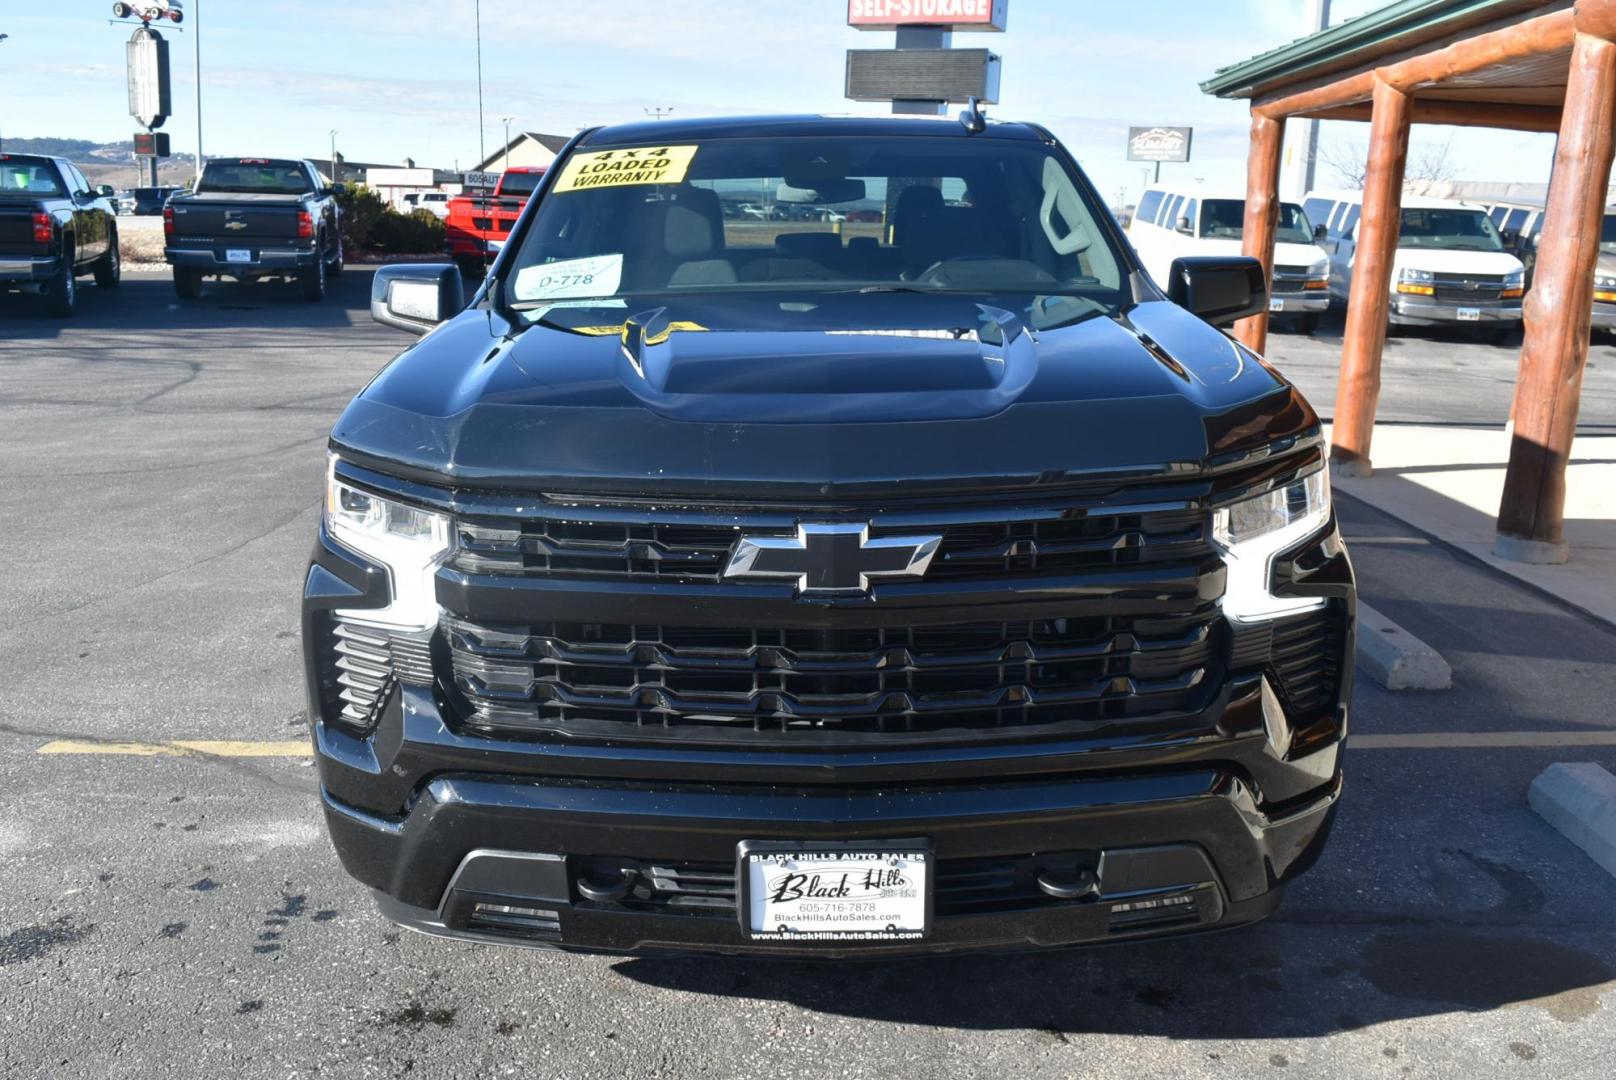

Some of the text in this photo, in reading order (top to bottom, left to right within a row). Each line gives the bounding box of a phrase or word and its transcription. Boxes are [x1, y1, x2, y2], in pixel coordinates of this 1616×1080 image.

[578, 158, 671, 175] LOADED
[572, 170, 666, 188] WARRANTY
[539, 274, 594, 288] D-778
[750, 854, 795, 863] BLACK
[799, 853, 837, 861] HILLS
[843, 853, 877, 861] AUTO
[764, 868, 905, 904] Black Hills
[799, 903, 876, 912] 605-716-7878
[774, 913, 901, 922] BlackHillsAutoSales.com
